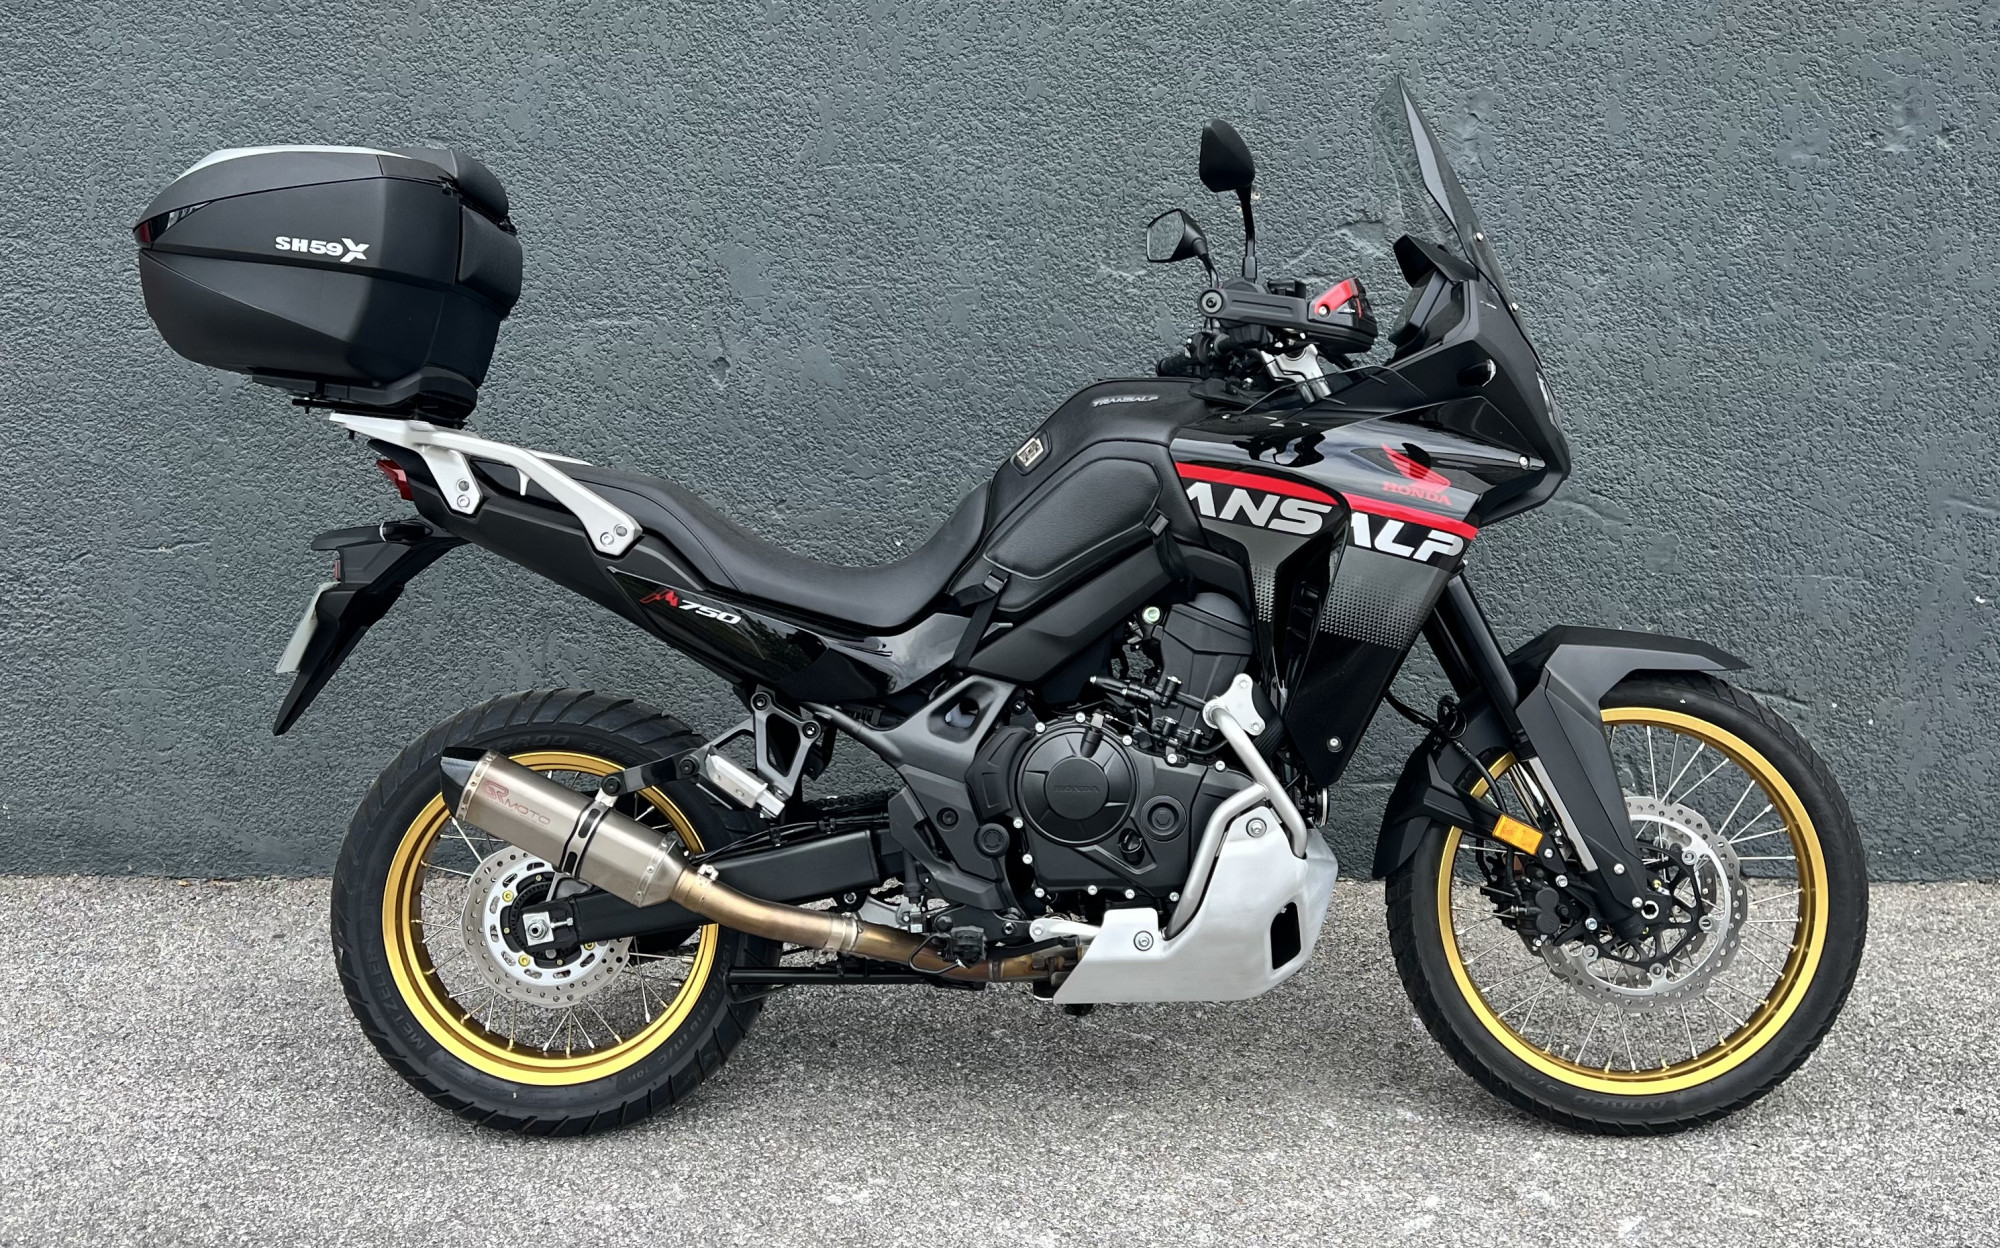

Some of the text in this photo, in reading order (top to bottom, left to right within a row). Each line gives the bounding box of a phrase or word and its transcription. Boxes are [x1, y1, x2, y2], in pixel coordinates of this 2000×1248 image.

[1382, 481, 1453, 506] HONDA
[679, 599, 742, 625] 750
[1052, 784, 1101, 793] HONDA
